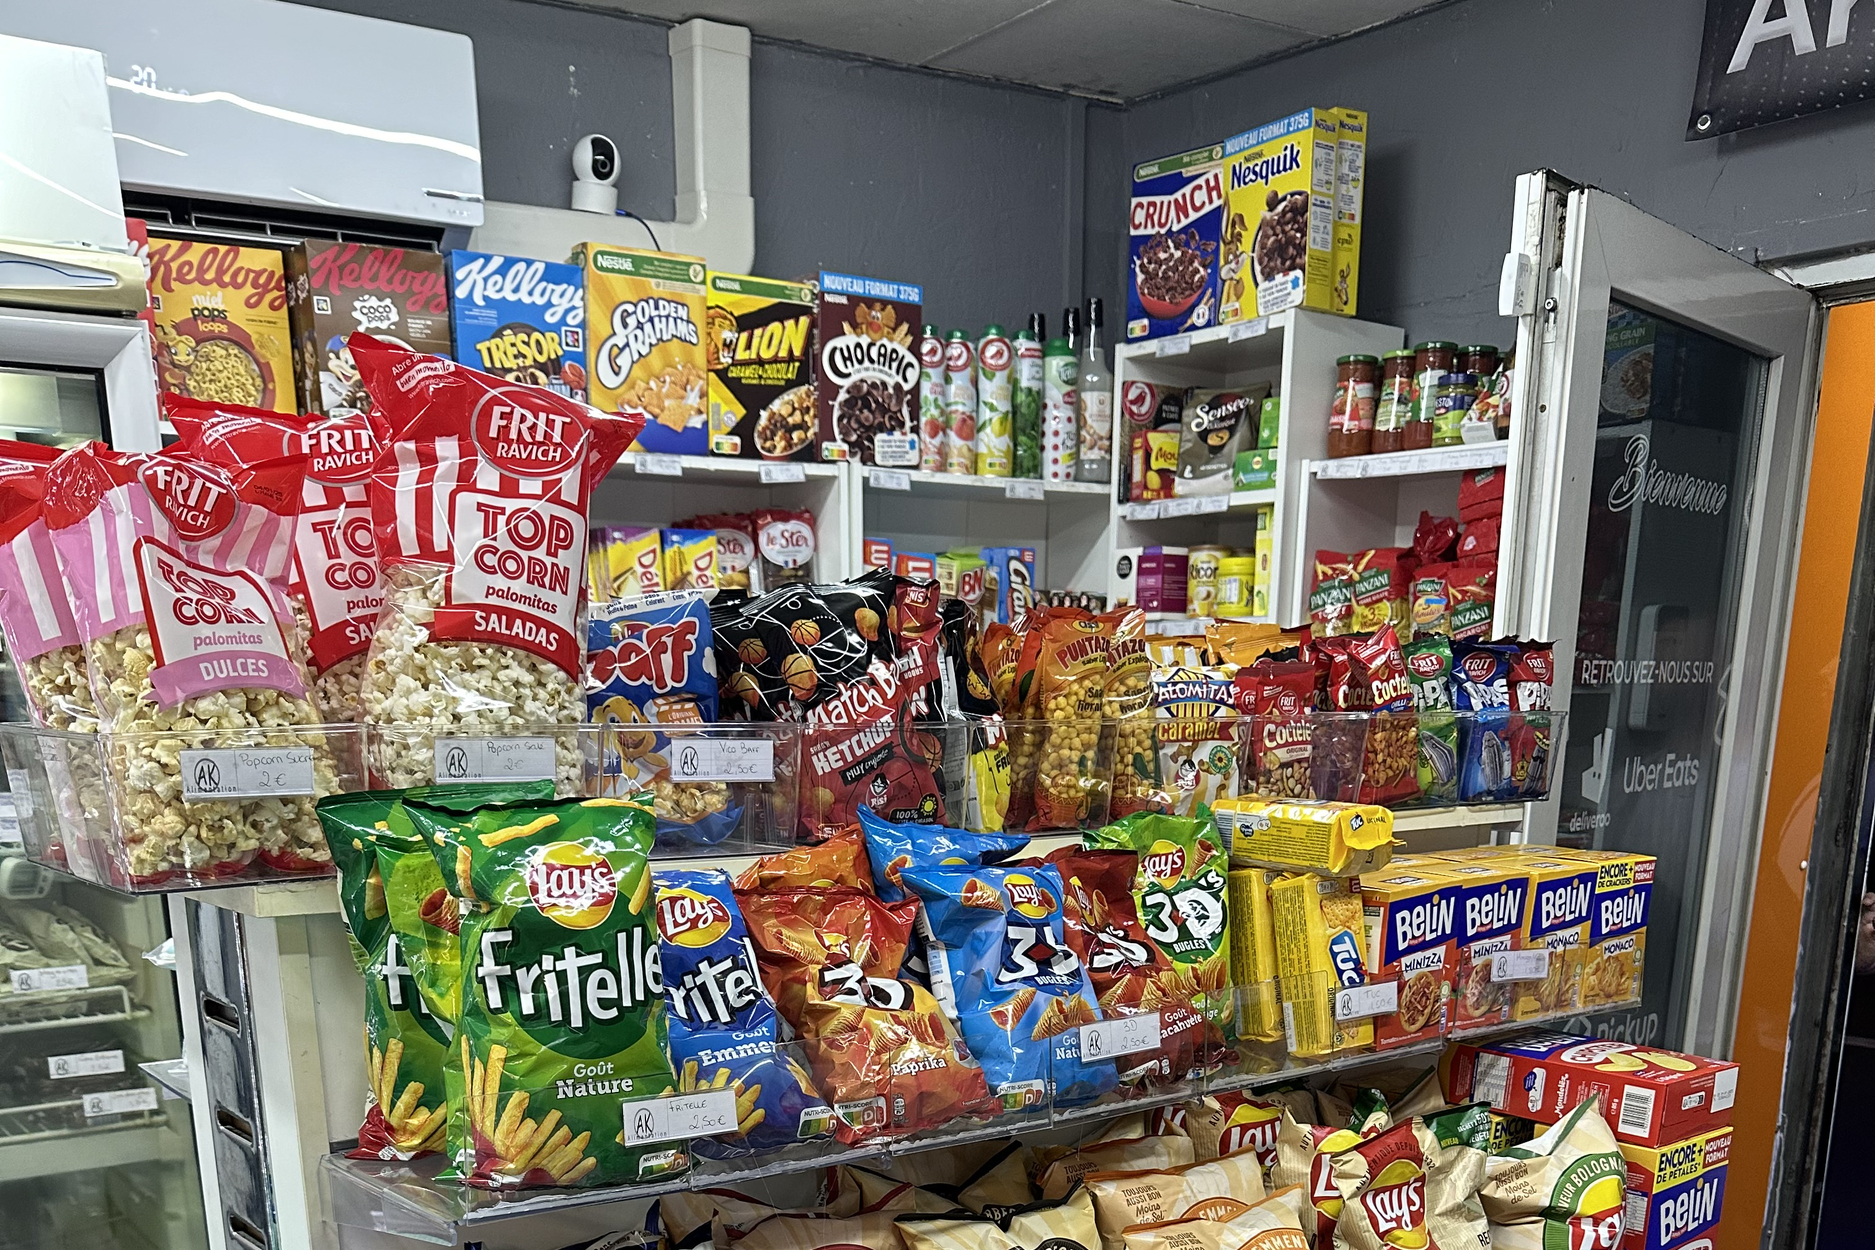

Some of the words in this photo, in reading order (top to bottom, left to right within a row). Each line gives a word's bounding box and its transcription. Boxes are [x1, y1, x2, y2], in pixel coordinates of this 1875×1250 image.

[1226, 132, 1258, 155] NOUVEAU
[1259, 123, 1288, 142] FORMAT
[1289, 113, 1309, 130] 375G
[1231, 143, 1300, 190] Nesquik
[1131, 172, 1222, 230] CRUNCH
[824, 275, 864, 292] NOUVEAU
[865, 281, 898, 298] FORMAT
[899, 287, 919, 301] 375G
[190, 307, 228, 322] pops
[612, 298, 689, 336] GOLDEN
[596, 315, 698, 389] GRAHAMS
[828, 342, 915, 383] CHOCAPIC
[488, 405, 571, 444] FRIT
[300, 429, 372, 454] FRIT
[496, 442, 562, 463] RAVICH
[313, 451, 374, 471] RAVICH
[1608, 433, 1728, 515] Bienvenue
[156, 466, 226, 513] FRIT
[165, 497, 211, 529] RAVICH
[476, 501, 575, 559] TOP
[158, 556, 236, 603] TOP
[474, 544, 570, 596] CORN
[962, 568, 984, 596] BN
[1355, 573, 1389, 595] PANZANI
[485, 584, 558, 615] palomitas
[1451, 606, 1489, 628] PANZANI
[193, 630, 263, 650] palomitas
[474, 610, 559, 651] SALADAS
[199, 658, 269, 681] DULCES
[1465, 658, 1491, 670] FRIT
[1581, 659, 1691, 685] RETROUVEZ-NOUS
[1692, 661, 1714, 683] SUR
[1281, 696, 1295, 706] FRIT
[719, 741, 736, 754] Vico
[811, 715, 895, 775] KETCHUP
[846, 763, 865, 781] MUY
[1623, 757, 1661, 793] Uber
[1663, 752, 1699, 788] Eats
[896, 811, 918, 819] 100%
[1569, 811, 1611, 832] deliveroo
[1599, 863, 1629, 879] ENCORE
[1634, 862, 1655, 873] NOUVEAU
[1635, 871, 1653, 881] FORMAT
[660, 893, 724, 933] Lay's
[1173, 939, 1206, 953] BUGLES
[1546, 931, 1580, 949] MONACO
[1603, 938, 1634, 955] MONACO
[1404, 953, 1442, 972] MINIZZA
[1165, 1008, 1187, 1023] Goût
[573, 1061, 614, 1076] Goût
[890, 1056, 947, 1075] Paprika
[556, 1077, 634, 1100] Nature
[1705, 1136, 1732, 1154] NOUVEAU
[1706, 1150, 1728, 1163] FORMAT
[1659, 1149, 1696, 1173] ENCORE
[1136, 1204, 1161, 1217] Moins
[1366, 1175, 1422, 1233] Lay's
